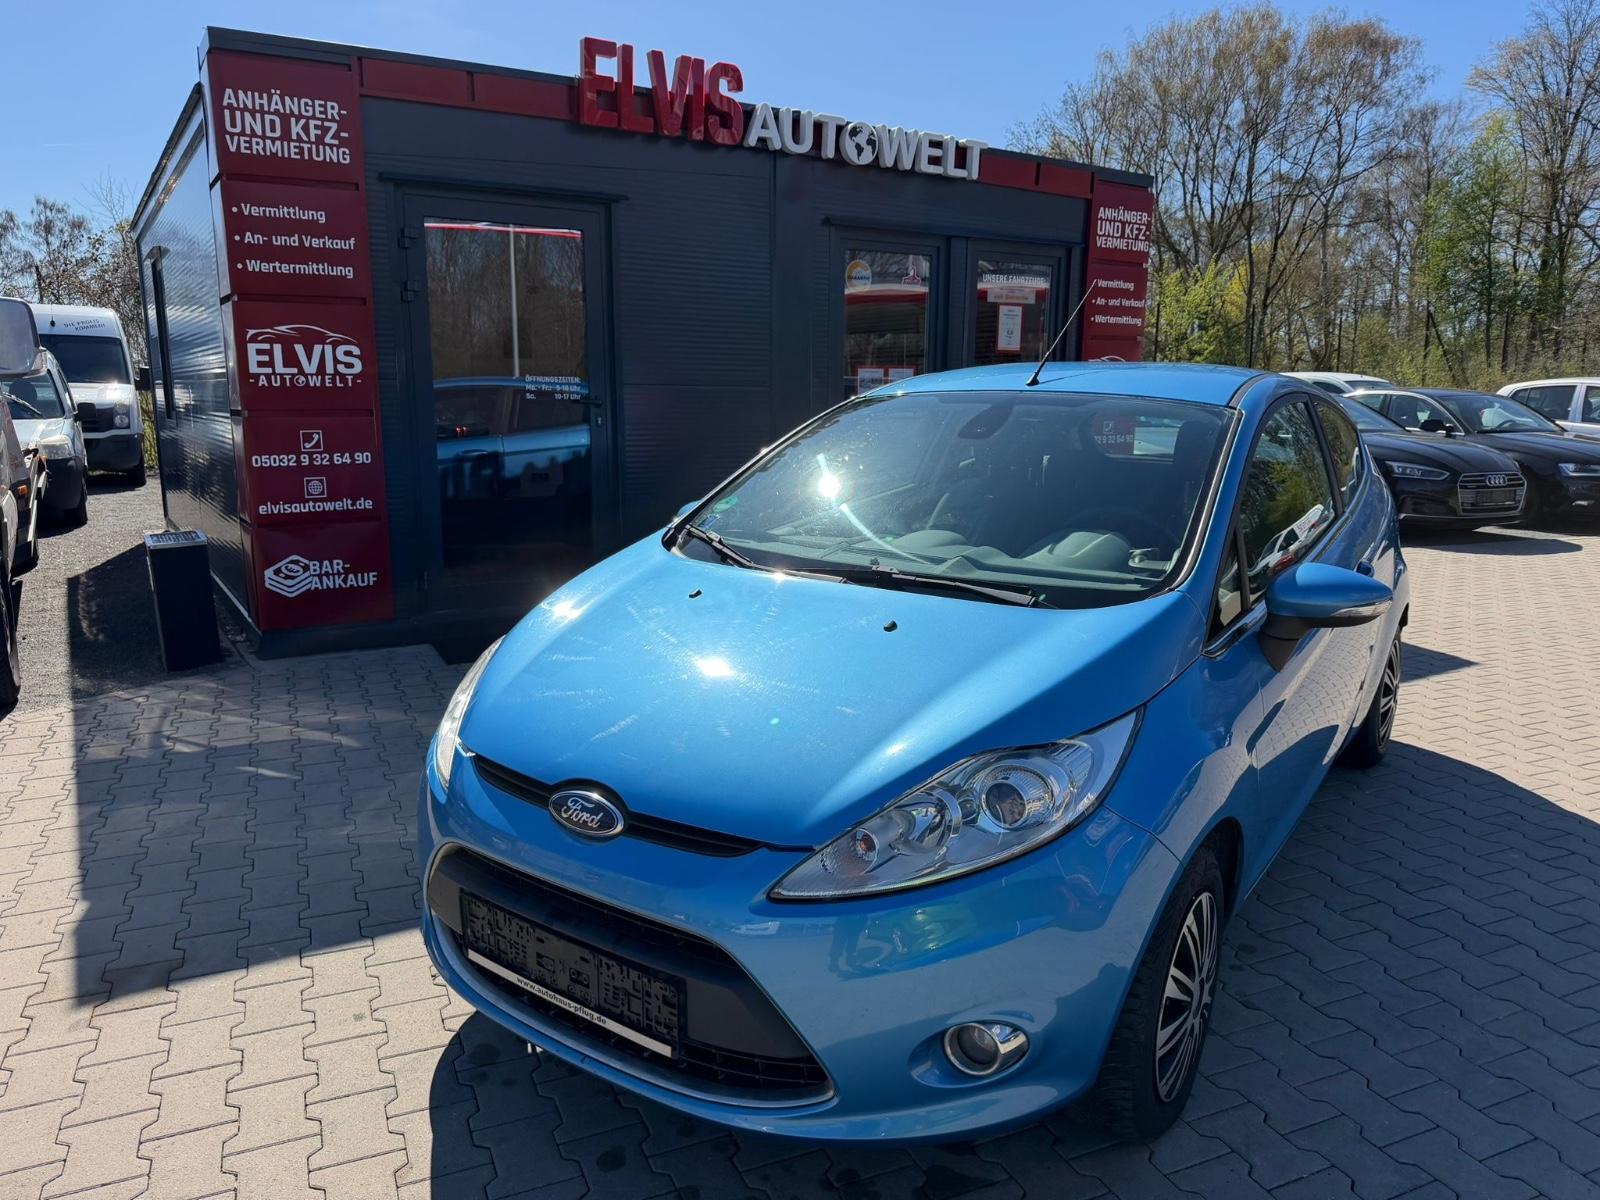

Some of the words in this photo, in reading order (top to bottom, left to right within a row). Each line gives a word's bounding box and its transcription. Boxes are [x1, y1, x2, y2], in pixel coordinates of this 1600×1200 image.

[580, 36, 744, 146] ELVIS
[222, 88, 347, 121] ANHÄNGER-
[224, 109, 282, 138] UND
[290, 117, 349, 145] KFZ-
[225, 134, 351, 164] VERMIETUNG
[241, 203, 326, 223] Vermittlung
[1098, 206, 1151, 225] ANHÄNGER-
[1097, 220, 1121, 238] UND
[1124, 226, 1150, 240] KFZ-
[244, 231, 268, 245] An-
[272, 234, 299, 247] und
[302, 236, 356, 250] Verkauf
[1096, 236, 1150, 252] VERMIETUNG
[246, 259, 354, 279] Wertermittlung
[1097, 278, 1135, 291] Vermittlung
[1108, 299, 1121, 307] und
[1121, 299, 1146, 308] Verkauf
[1095, 314, 1142, 326] Wertermittlung
[246, 342, 363, 375] ELVIS
[252, 453, 297, 468] 05032
[300, 453, 310, 467] 9
[313, 453, 330, 466] 32
[333, 453, 352, 466] 64
[354, 452, 372, 465] 90
[258, 498, 374, 515] elvisautowelt.de
[309, 560, 350, 575] BAR-
[311, 572, 378, 590] ANKAUF
[561, 797, 601, 828] Ford
[516, 976, 607, 1025] www.autohaus-pflug.de
